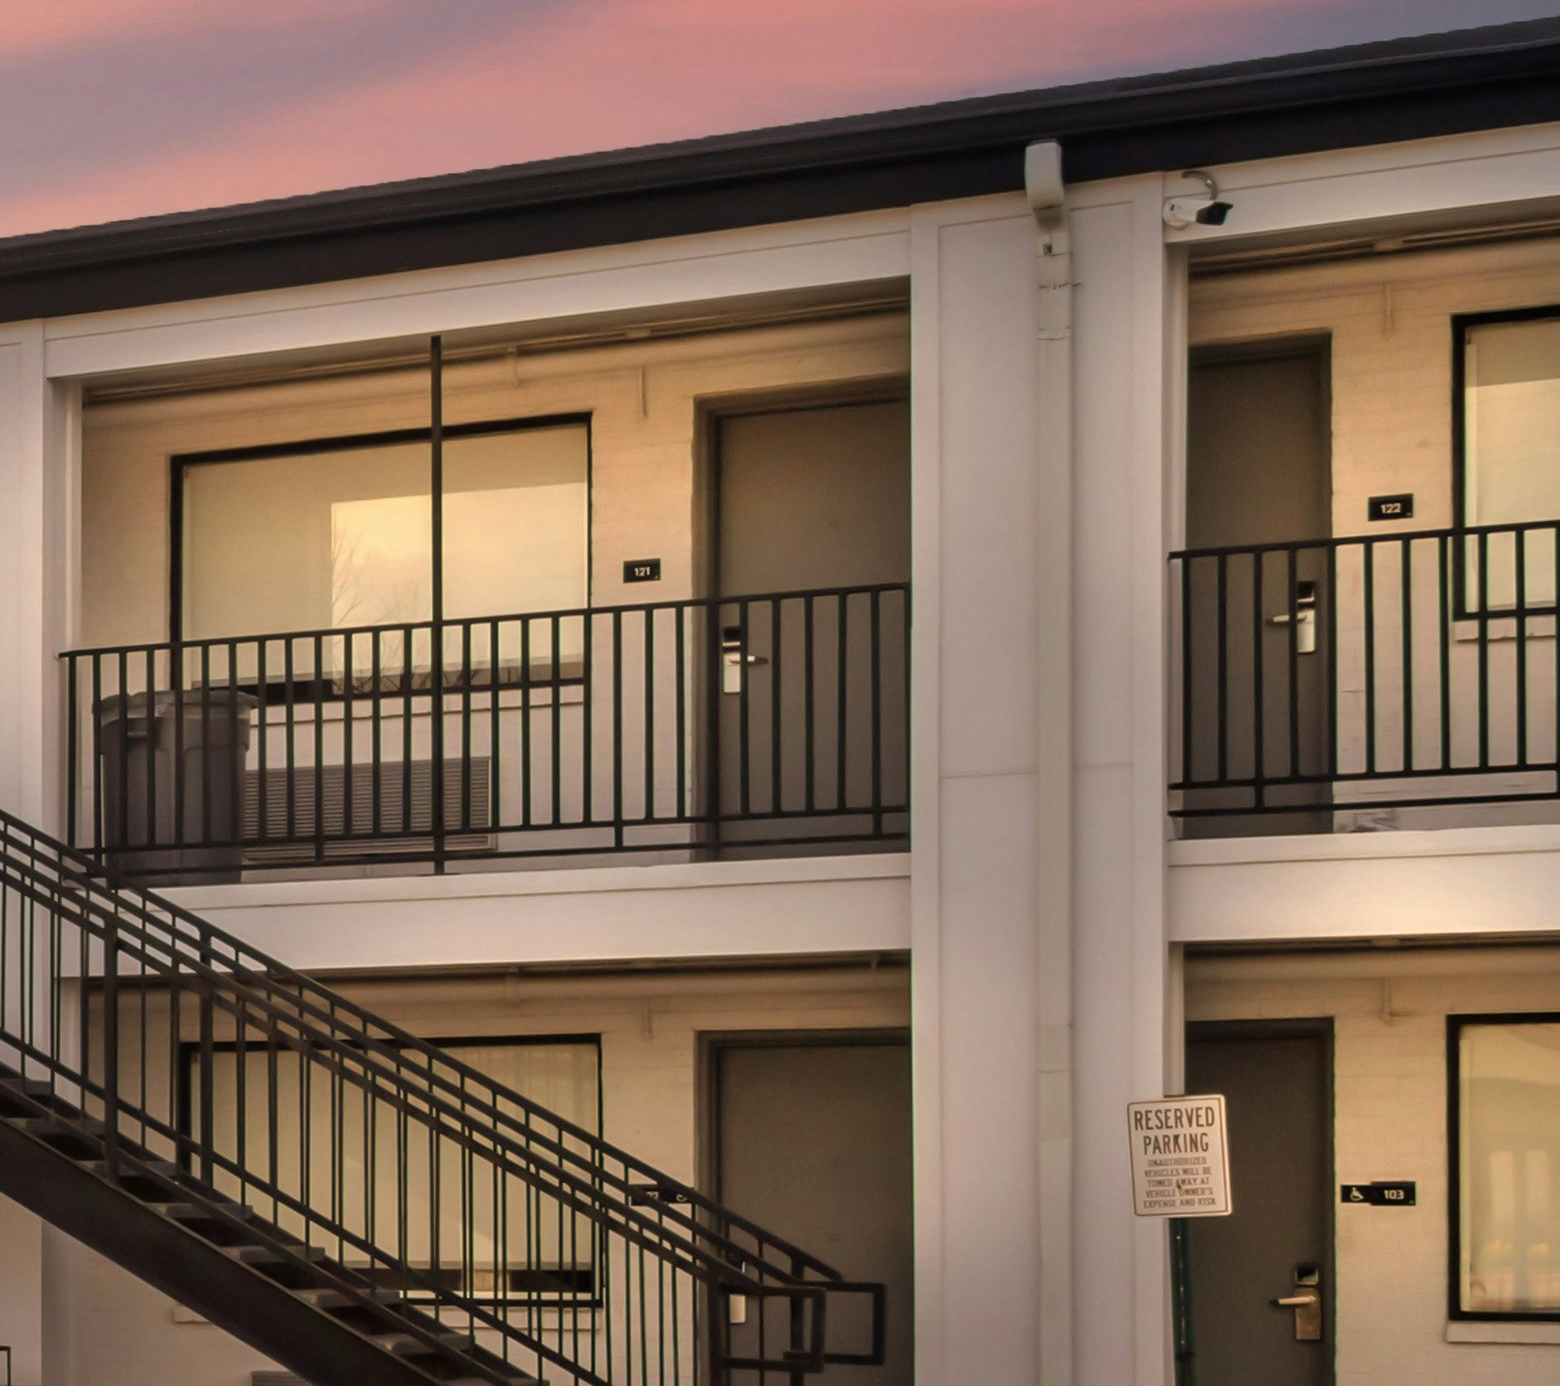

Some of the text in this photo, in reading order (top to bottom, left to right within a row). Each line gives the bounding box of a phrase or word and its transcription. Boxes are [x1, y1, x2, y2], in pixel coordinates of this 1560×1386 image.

[1381, 502, 1401, 514] 122
[634, 566, 650, 577] 121
[1134, 1106, 1215, 1131] RESERVED
[1143, 1132, 1209, 1155] PARKING
[1147, 1156, 1208, 1167] UNAUTHORIZED
[1144, 1168, 1180, 1177] VEHICLES
[1182, 1167, 1200, 1176] WILL
[1148, 1176, 1210, 1187] TOWED AWAY AT
[1145, 1188, 1176, 1198] VEHICLE
[1384, 1189, 1405, 1200] 103
[1143, 1197, 1217, 1209] EXPENSE AND RISK
